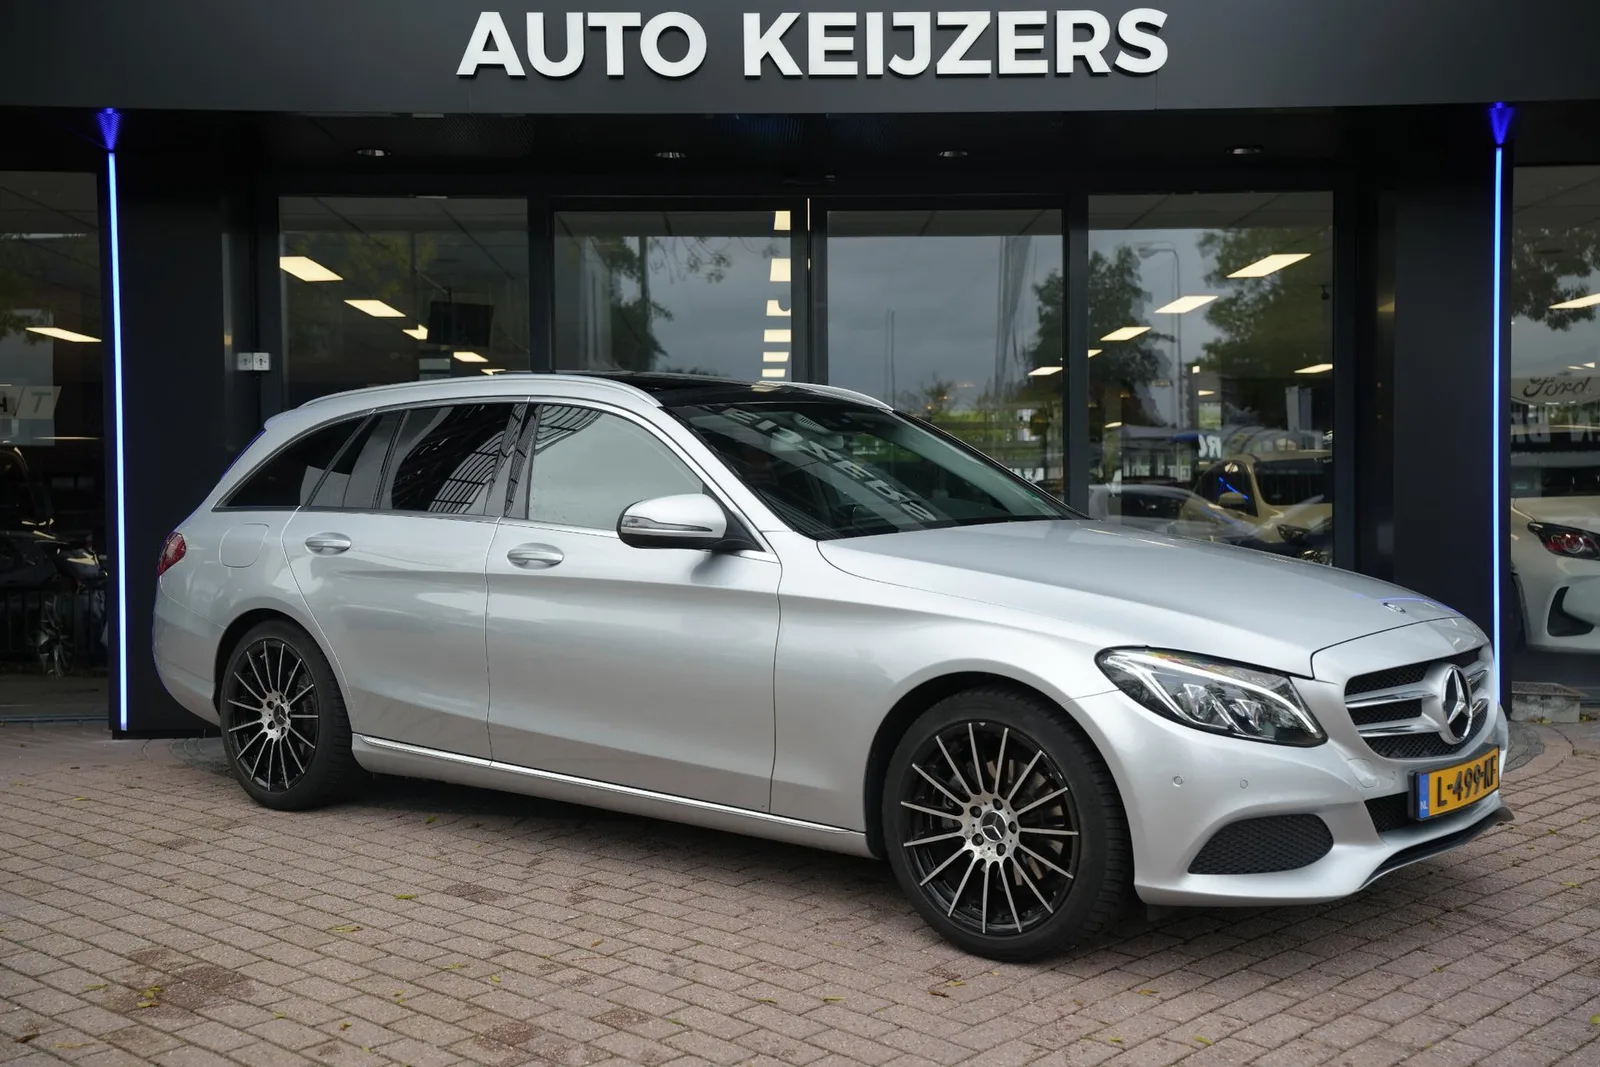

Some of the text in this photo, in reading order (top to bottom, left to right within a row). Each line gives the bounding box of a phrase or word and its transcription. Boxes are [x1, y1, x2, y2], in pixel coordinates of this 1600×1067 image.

[457, 8, 1169, 78] AUTO KEIJZERS
[1522, 376, 1592, 398] Ford
[1420, 800, 1428, 810] NL
